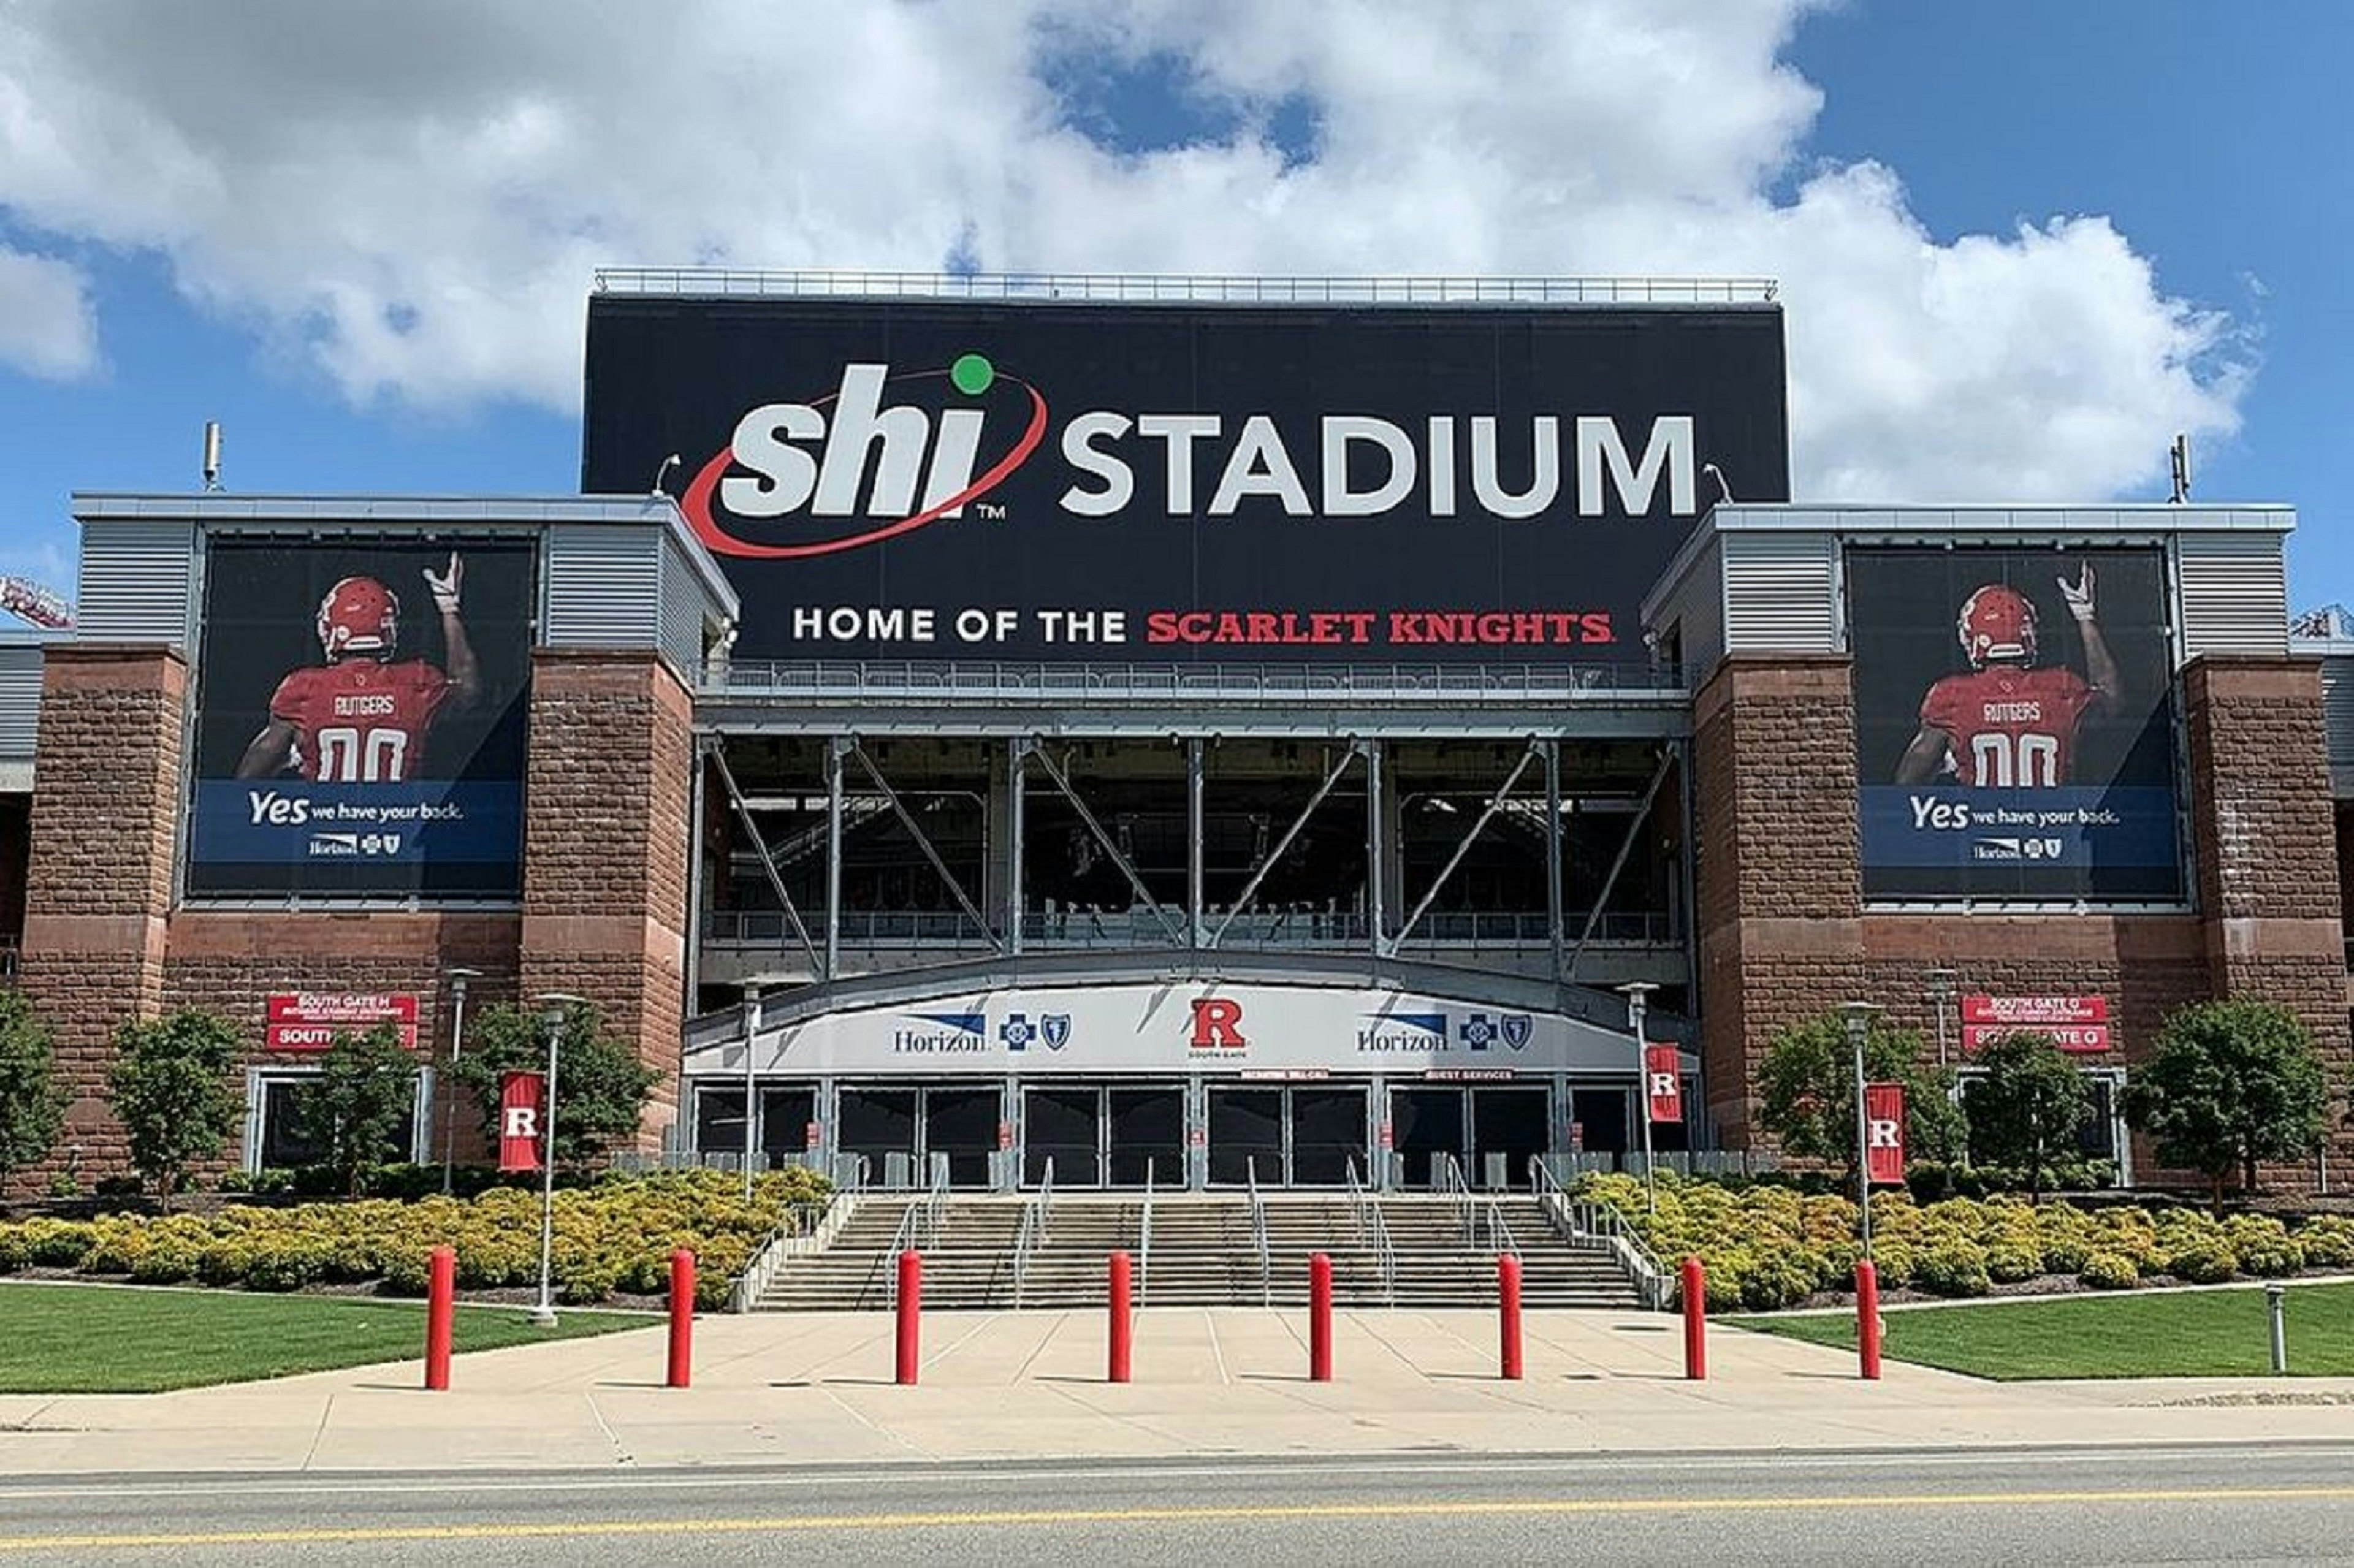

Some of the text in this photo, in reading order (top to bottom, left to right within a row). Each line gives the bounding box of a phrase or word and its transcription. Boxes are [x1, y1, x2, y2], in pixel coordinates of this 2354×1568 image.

[722, 356, 1696, 519] shi STADIUM
[977, 504, 1006, 519] TM
[793, 609, 934, 641] HOME
[956, 609, 1018, 642] OF
[1038, 611, 1127, 642] THE
[1148, 612, 1376, 643] SCARLET
[335, 695, 394, 716] RUTGERS
[1984, 701, 2041, 721] RUTGERS
[248, 791, 309, 824] Yes
[312, 807, 335, 819] we
[338, 802, 377, 820] have
[379, 806, 419, 823] your
[1910, 796, 1968, 828] Yes
[1973, 812, 1996, 824] we
[1998, 808, 2036, 824] have
[2038, 812, 2075, 828] your
[299, 995, 341, 1008] SOUTH
[343, 995, 376, 1007] GATE
[1991, 998, 2032, 1010] SOUTH
[2035, 998, 2068, 1009] GATE
[1191, 998, 1246, 1048] R
[895, 1030, 985, 1052] Horizon
[1357, 1030, 1449, 1051] Horizon
[1651, 1073, 1677, 1097] R
[506, 1108, 538, 1137] R
[1870, 1120, 1900, 1147] R
